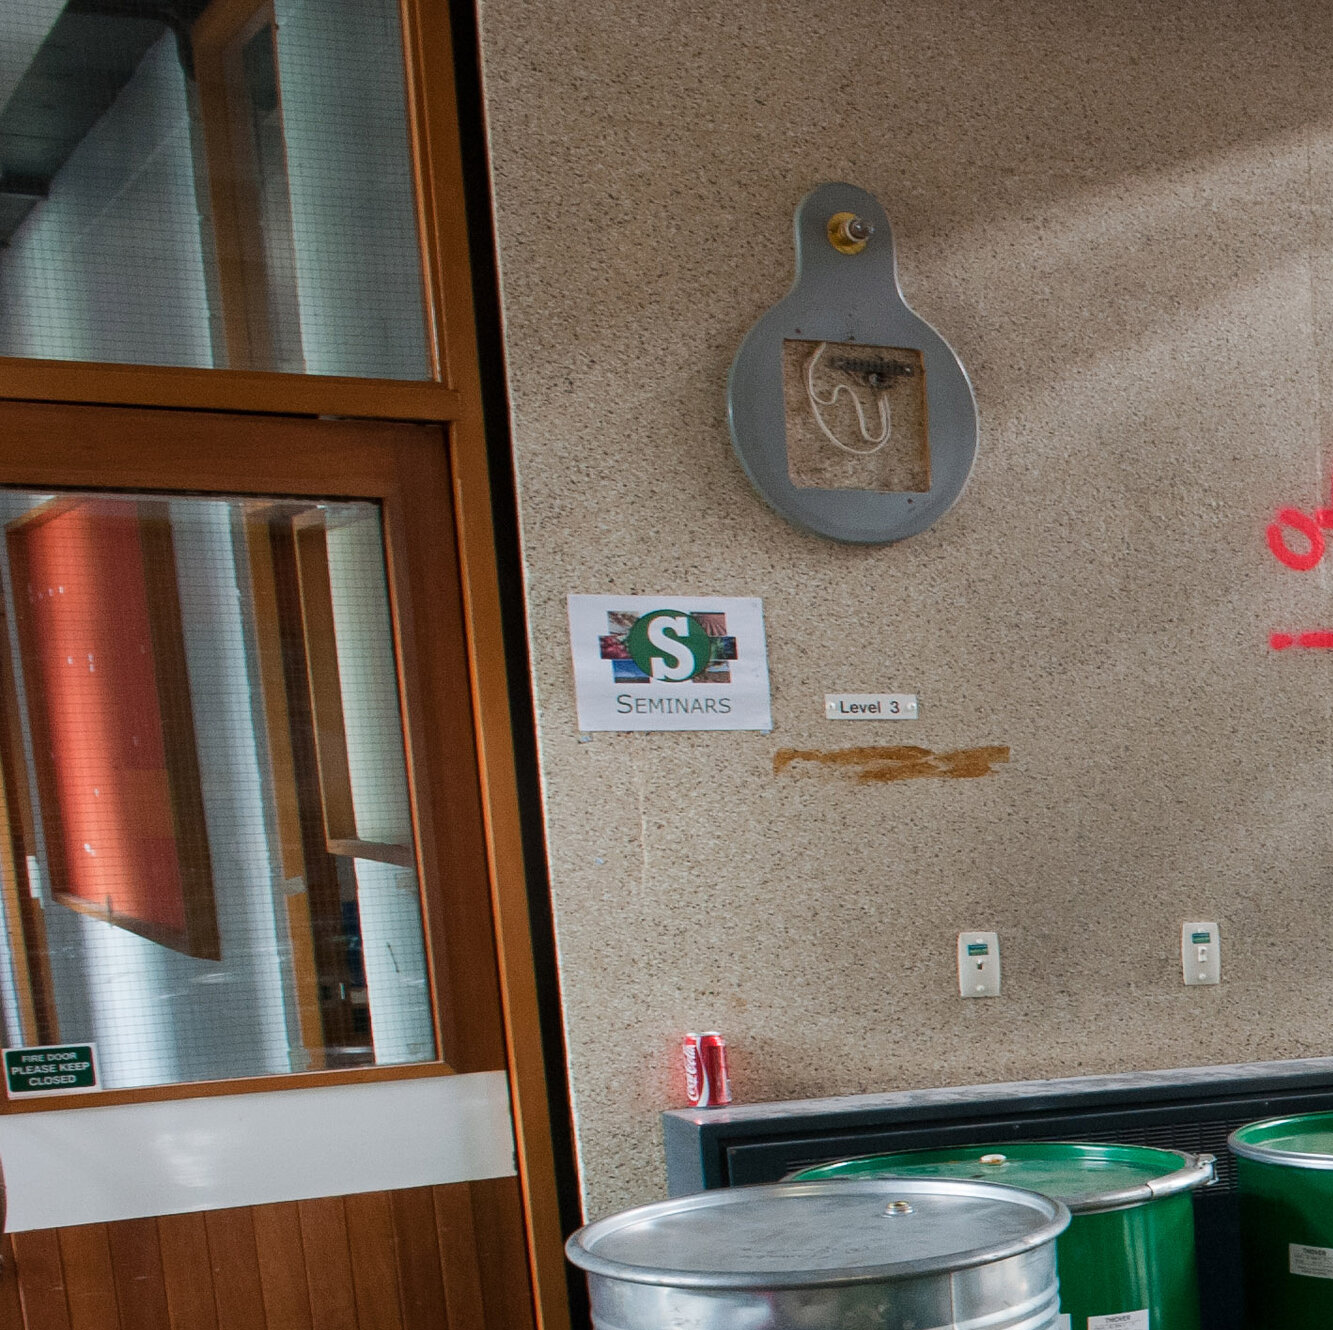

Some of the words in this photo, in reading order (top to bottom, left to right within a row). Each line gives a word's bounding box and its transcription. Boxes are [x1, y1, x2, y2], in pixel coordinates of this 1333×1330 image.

[616, 694, 732, 715] SEMINARS
[839, 700, 882, 715] Level
[889, 700, 900, 715] 3
[22, 1055, 44, 1063] FIRE
[47, 1052, 78, 1061] DOOR
[11, 1064, 57, 1075] PLEASE
[59, 1062, 90, 1072] KEEP
[28, 1075, 77, 1087] CLOSED
